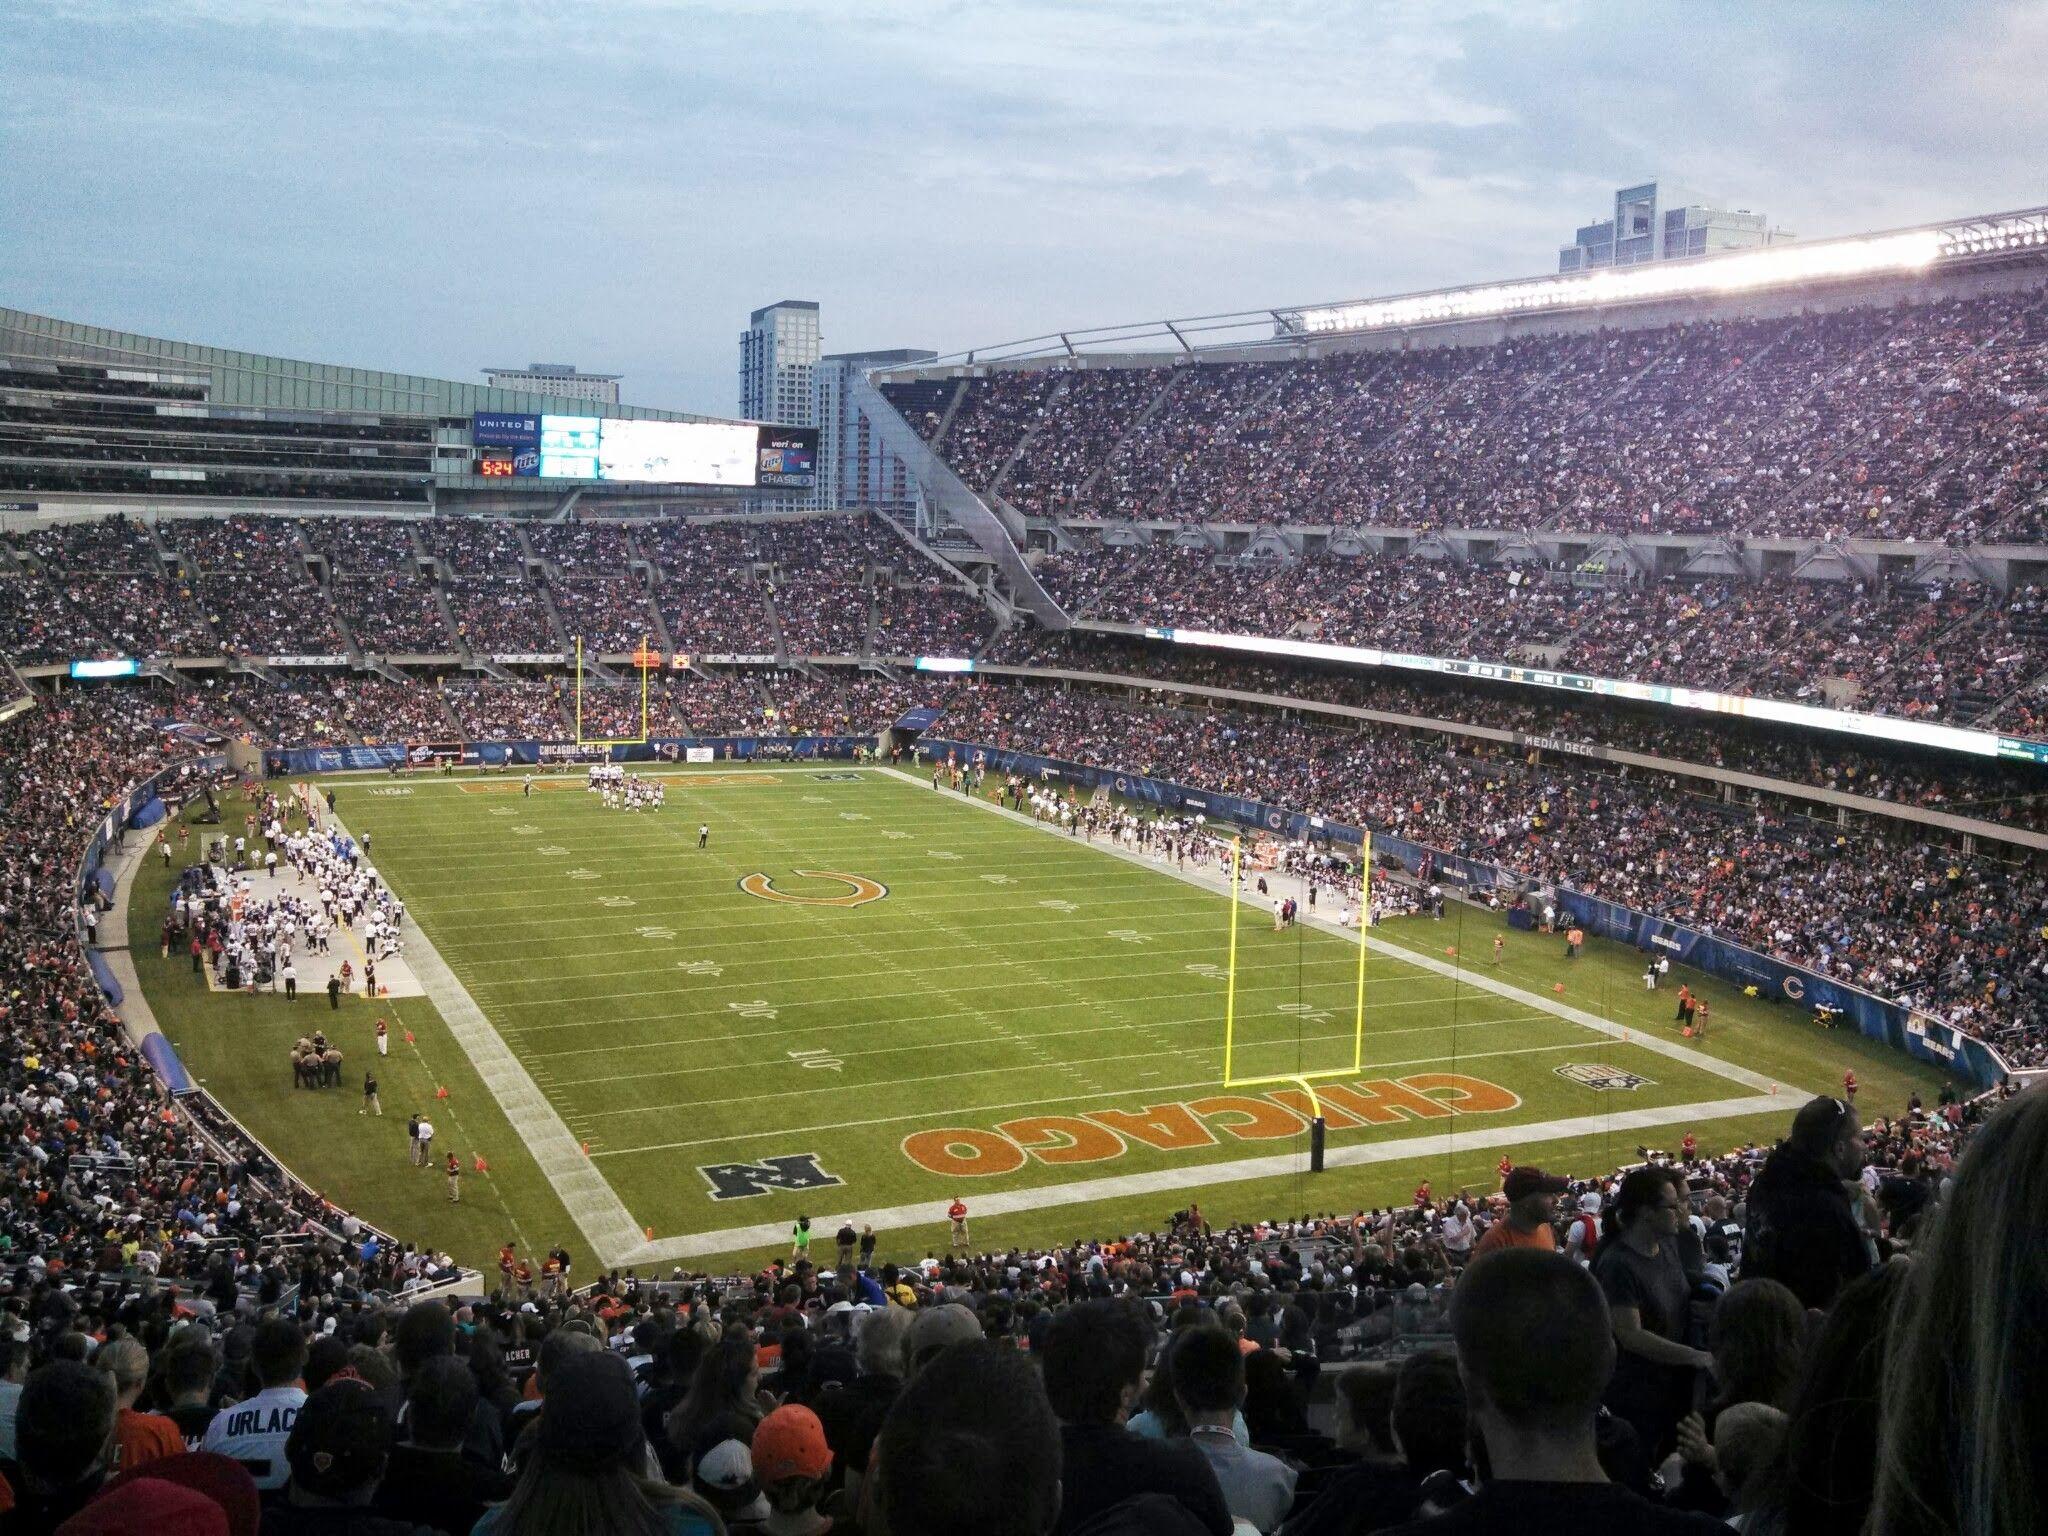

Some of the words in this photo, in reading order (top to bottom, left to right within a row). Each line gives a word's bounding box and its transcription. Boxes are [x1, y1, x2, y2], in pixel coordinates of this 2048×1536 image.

[480, 420, 522, 429] UNITED
[771, 440, 804, 449] verion
[482, 461, 513, 476] 5:24
[761, 474, 798, 484] CHASE
[539, 744, 613, 755] CHICAGOBERS.COM
[1525, 735, 1560, 751] MEDIA
[1564, 742, 1594, 757] DECK
[1650, 934, 1682, 952] BEARS
[677, 959, 724, 975] 30
[728, 1000, 779, 1018] 20
[1922, 1036, 1956, 1061] BEARS
[787, 1048, 844, 1069] 10
[900, 1072, 1523, 1179] CHICAGO
[226, 1406, 302, 1438] URLAC
